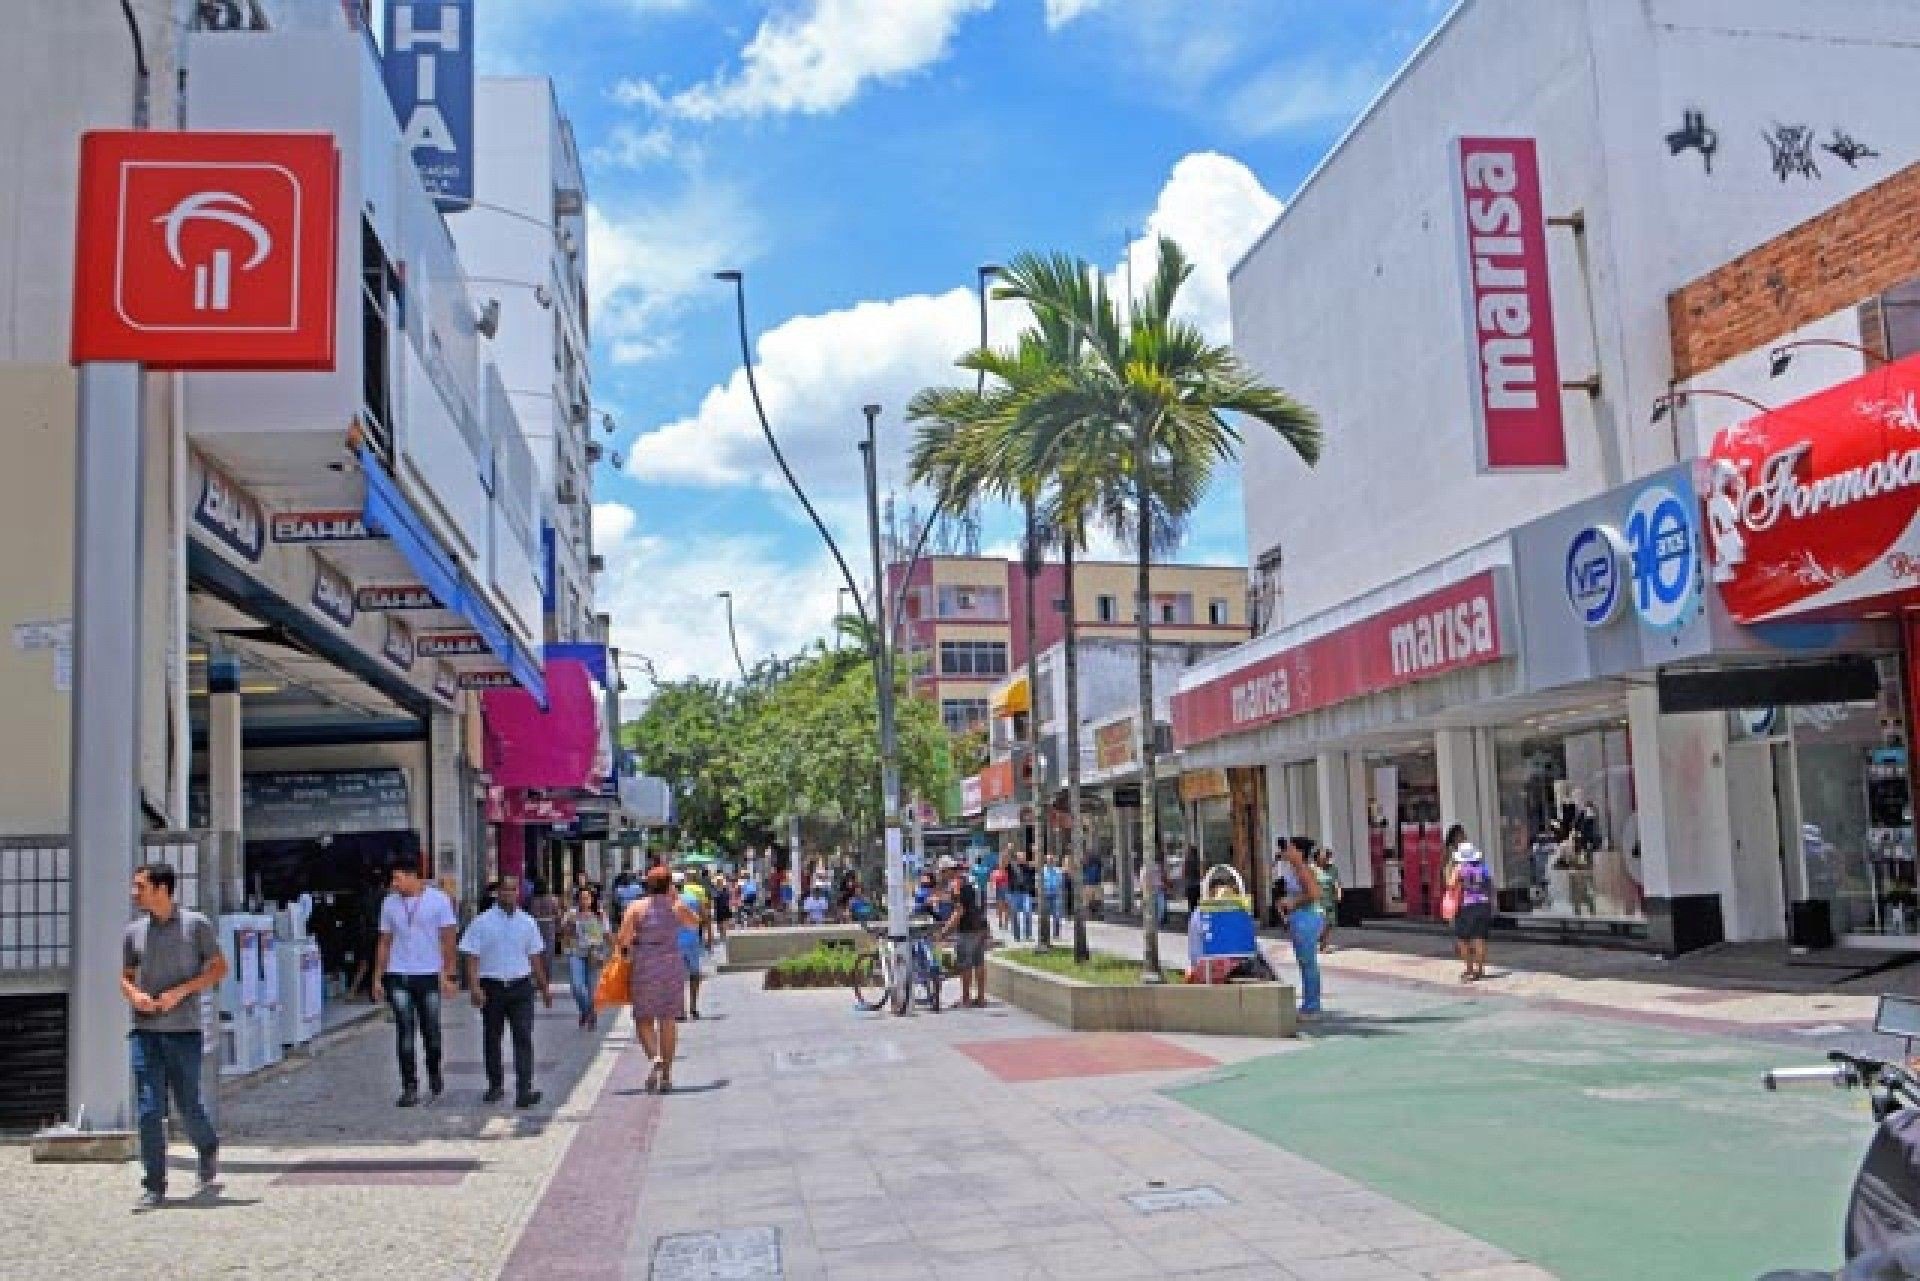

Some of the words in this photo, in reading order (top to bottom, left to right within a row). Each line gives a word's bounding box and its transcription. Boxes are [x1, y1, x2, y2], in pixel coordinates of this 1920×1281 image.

[1466, 152, 1540, 409] marisa
[274, 518, 368, 538] BAHIA
[1743, 439, 1920, 531] Formosa
[1628, 498, 1690, 610] 10
[1389, 596, 1493, 685] marisa
[1232, 667, 1292, 724] marisa
